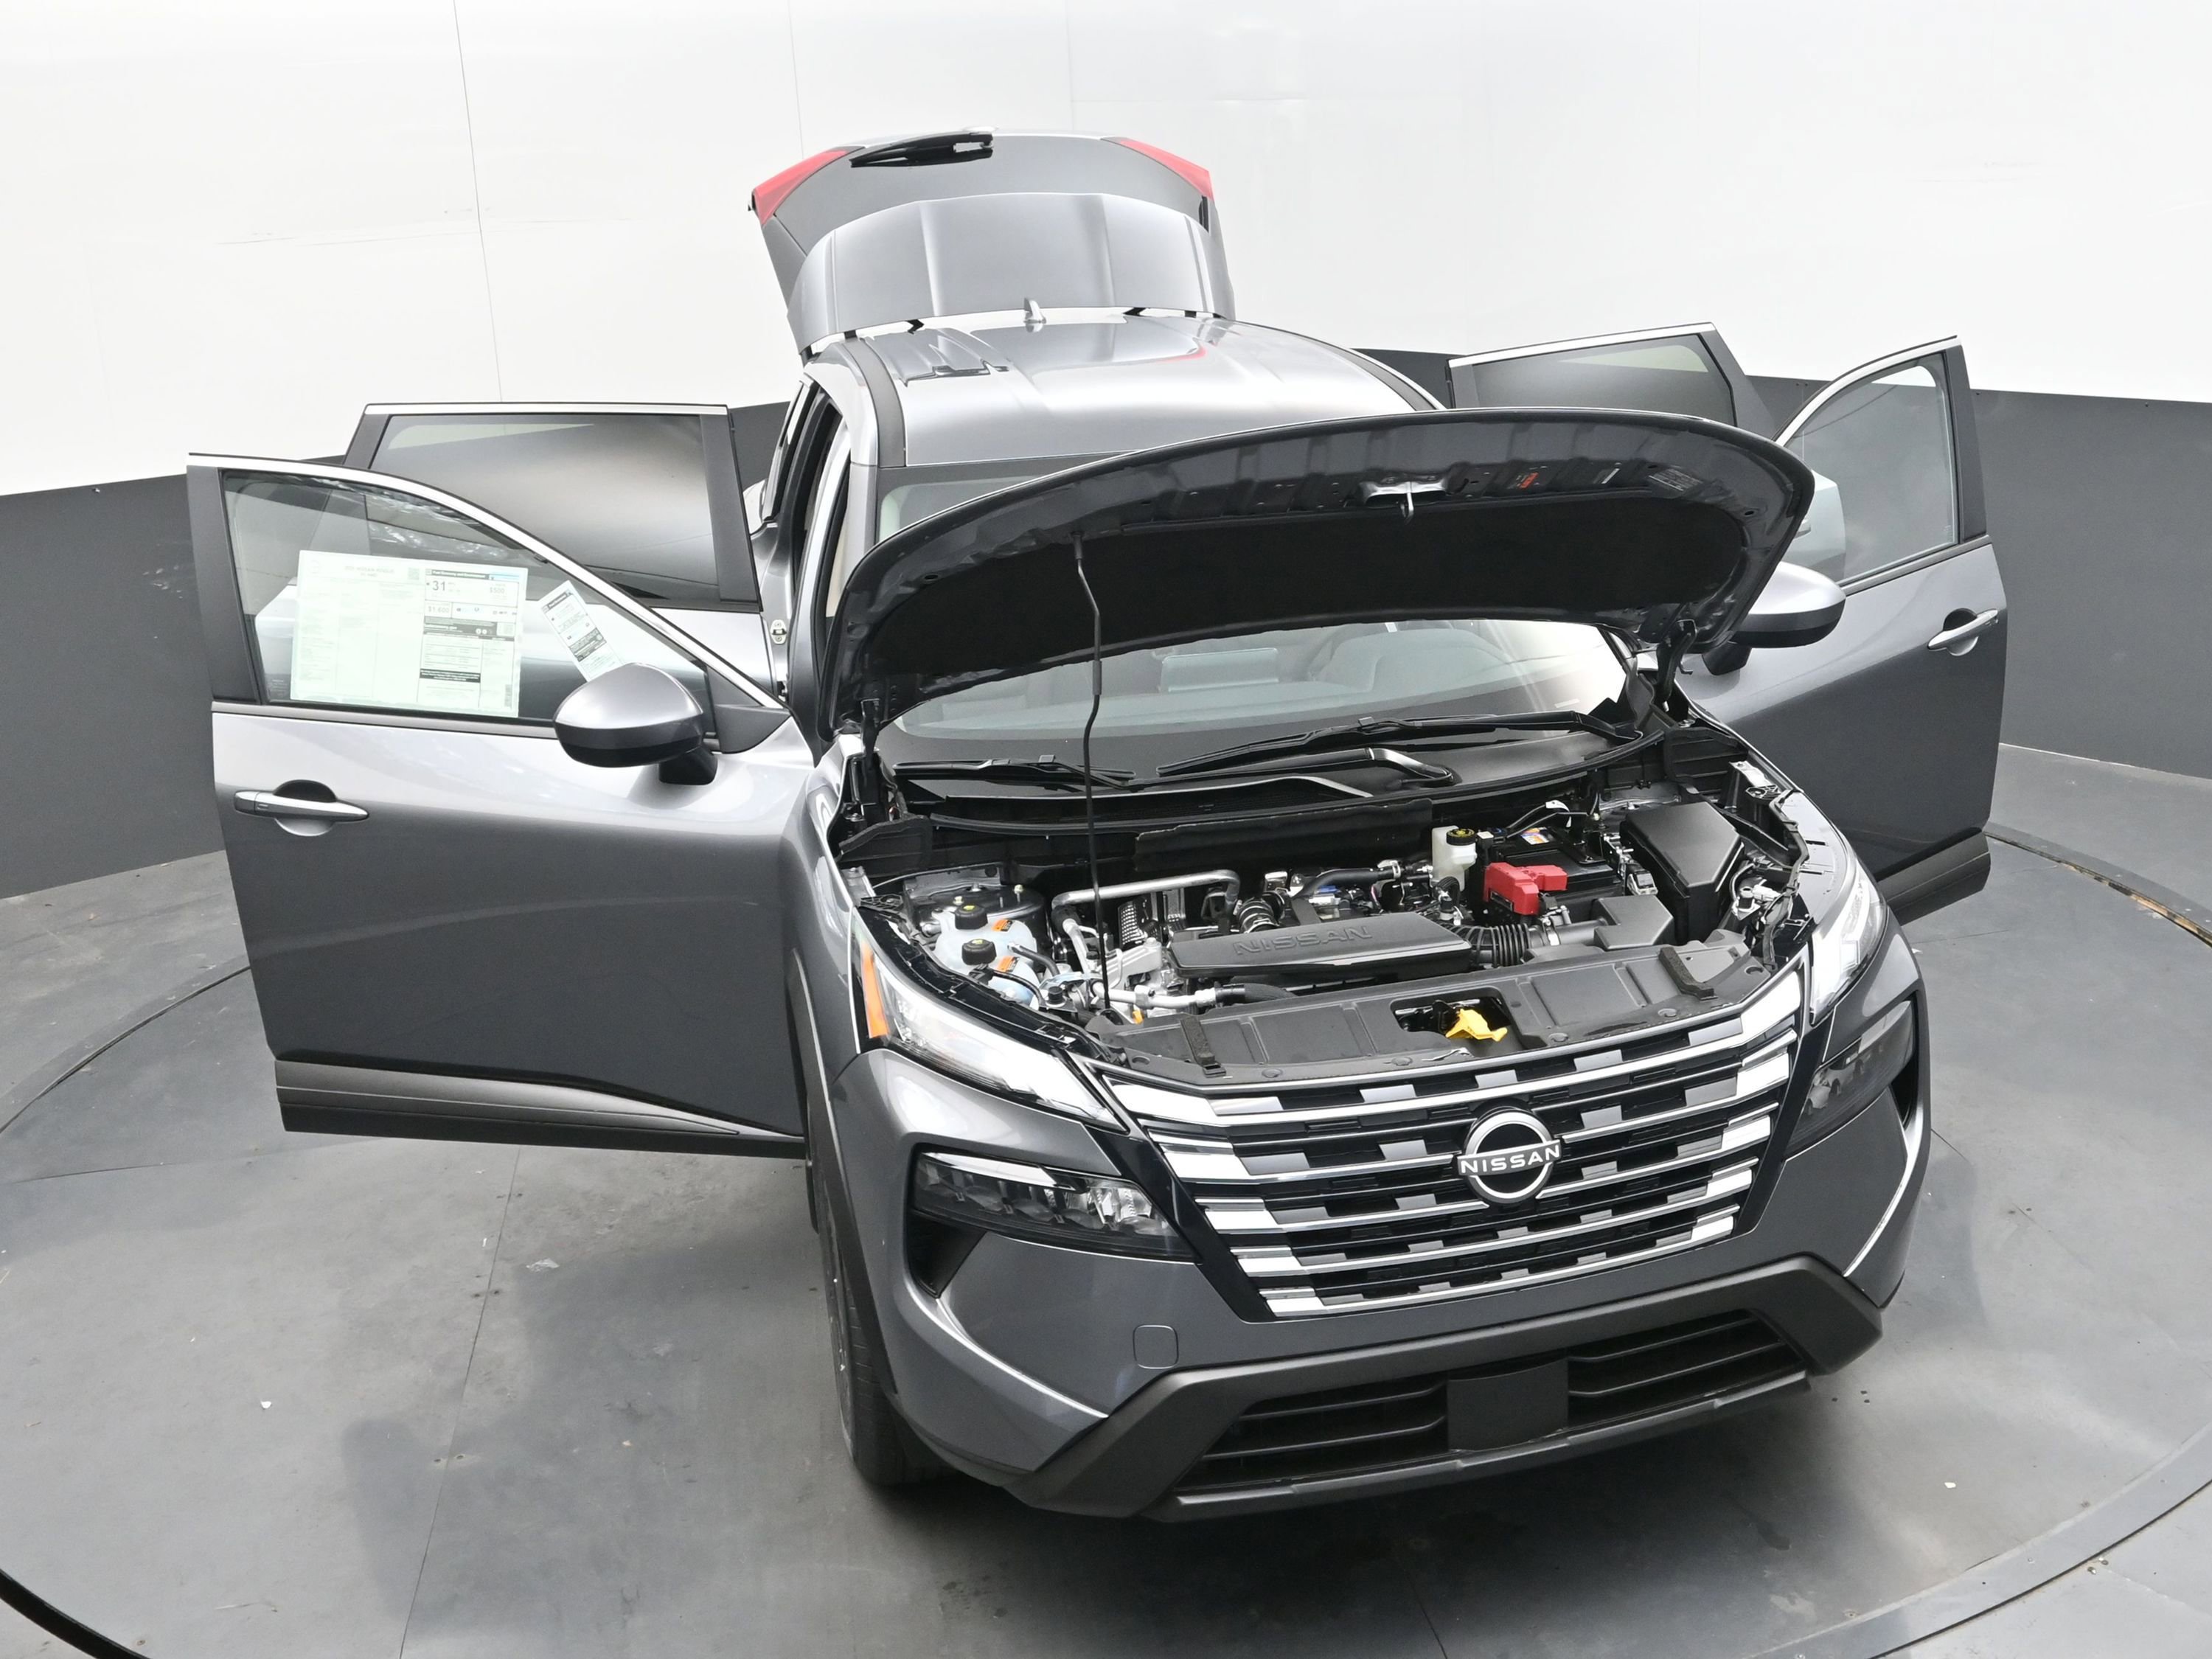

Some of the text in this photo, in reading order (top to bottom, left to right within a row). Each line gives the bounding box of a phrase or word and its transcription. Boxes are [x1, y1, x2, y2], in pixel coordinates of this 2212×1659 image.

[432, 580, 445, 591] 31
[1233, 925, 1373, 956] NISSAN
[1460, 1144, 1560, 1174] NISSAN
